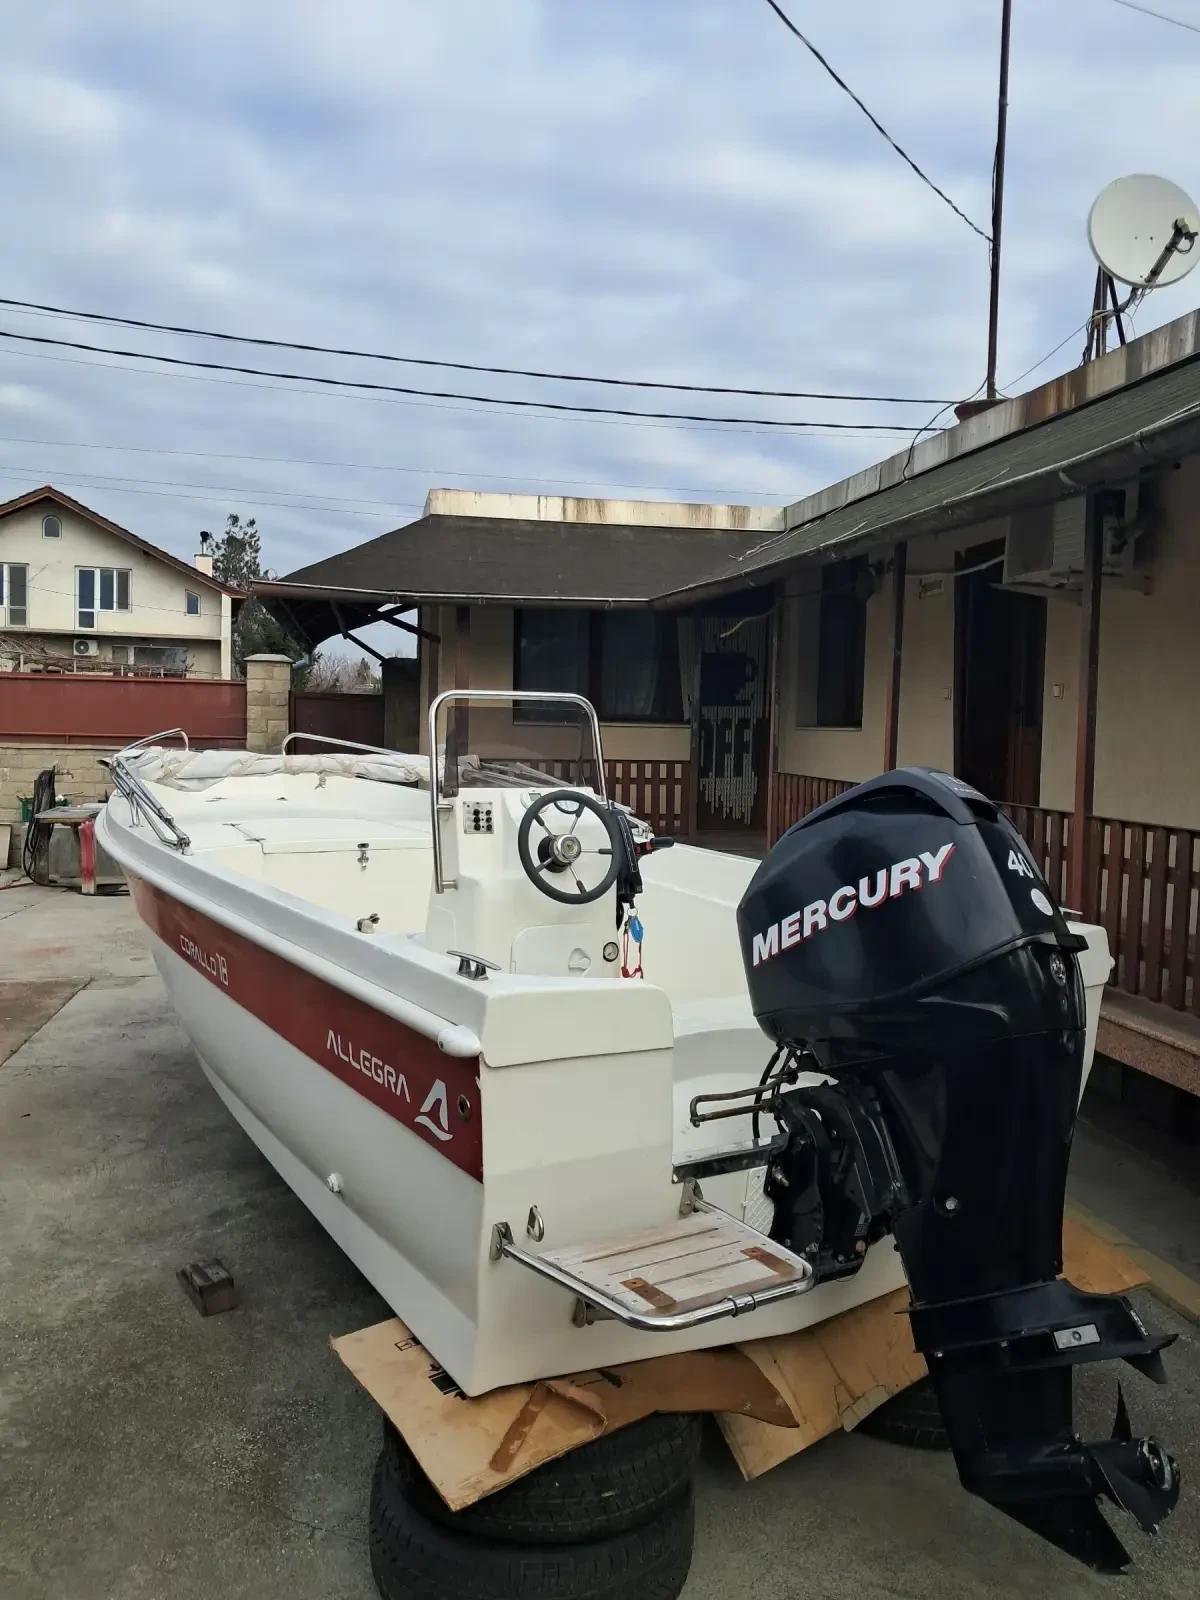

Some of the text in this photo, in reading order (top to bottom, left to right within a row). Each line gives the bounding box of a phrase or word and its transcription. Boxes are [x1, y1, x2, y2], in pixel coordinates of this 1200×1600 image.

[1007, 849, 1034, 879] 40
[752, 842, 956, 968] MERCURY
[326, 1029, 411, 1104] ALLEGRA
